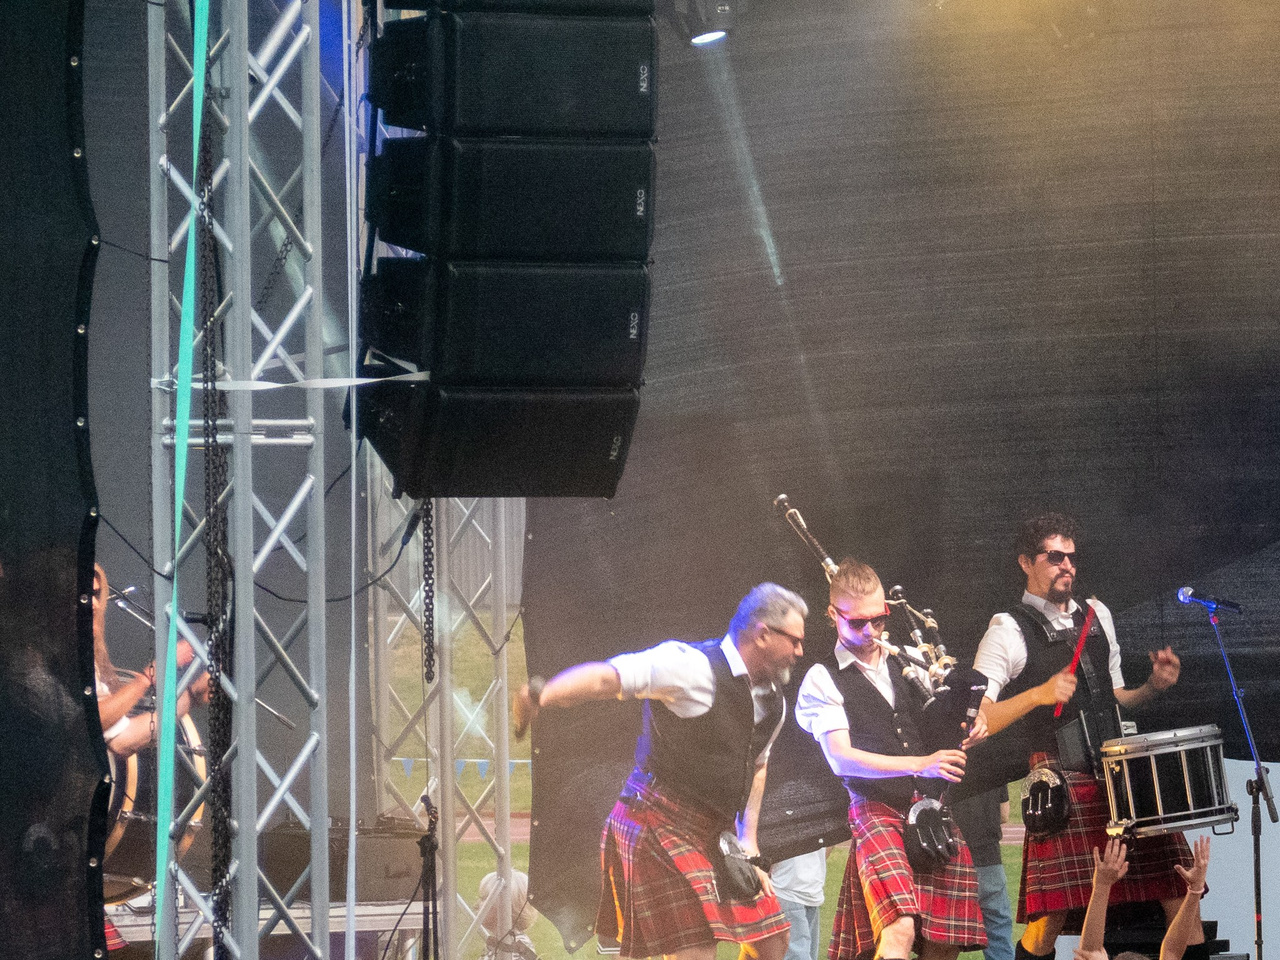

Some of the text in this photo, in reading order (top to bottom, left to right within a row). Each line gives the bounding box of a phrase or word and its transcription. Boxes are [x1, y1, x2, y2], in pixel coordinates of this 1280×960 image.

[640, 65, 648, 91] NEXO
[636, 189, 645, 216] NEXO
[629, 312, 639, 339] NEXO
[609, 436, 621, 460] NEXO
